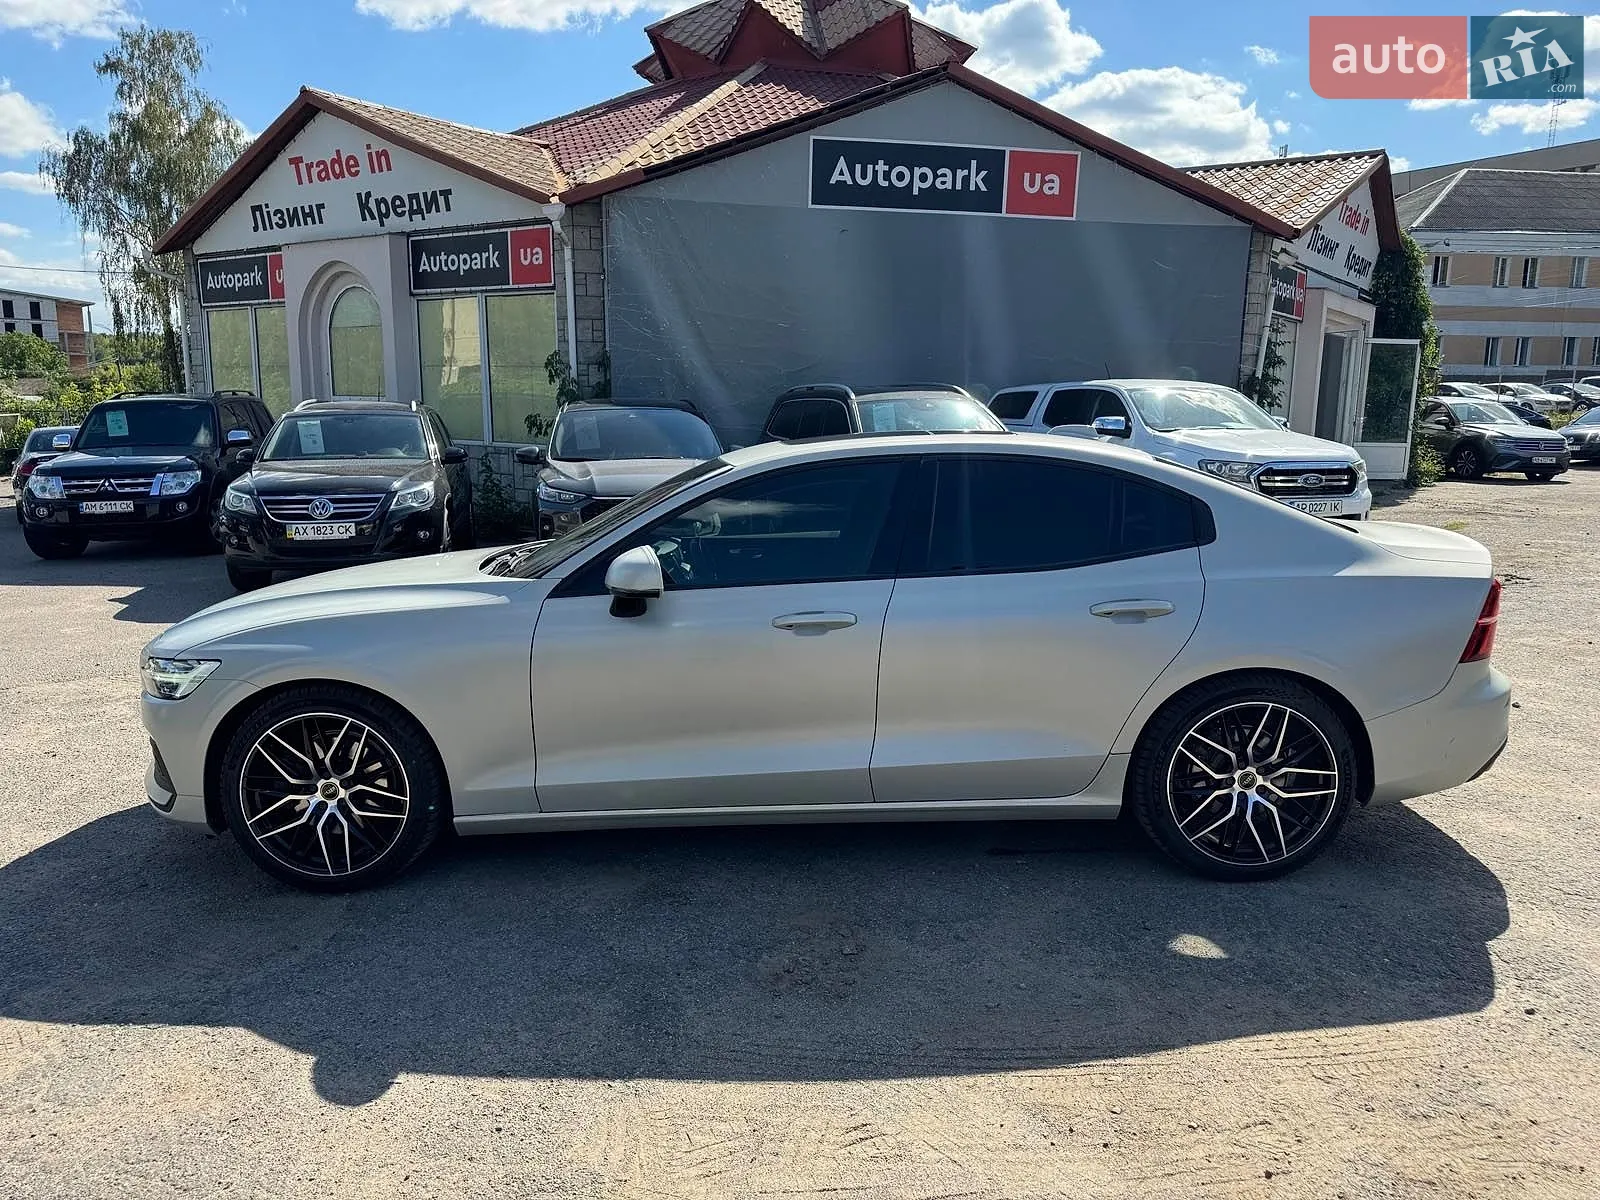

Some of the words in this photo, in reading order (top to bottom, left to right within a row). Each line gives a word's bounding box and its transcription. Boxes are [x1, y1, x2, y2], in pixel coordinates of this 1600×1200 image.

[288, 150, 360, 186] Trade
[366, 143, 393, 174] in
[829, 155, 989, 196] Autopark
[1023, 171, 1061, 196] ua
[250, 200, 326, 233] Лізинг
[356, 188, 453, 228] Кредит
[1338, 196, 1362, 232] Trade
[1359, 209, 1370, 236] in
[418, 243, 501, 276] Autopark
[519, 246, 543, 266] ua
[1306, 223, 1340, 261] Лізинг
[1343, 244, 1372, 279] Кредит
[206, 264, 263, 292] Autopark
[275, 268, 284, 284] u
[1308, 502, 1328, 513] 0227
[1330, 502, 1340, 512] IK
[294, 525, 309, 536] AX
[310, 525, 334, 536] 1823
[336, 524, 353, 535] CK
